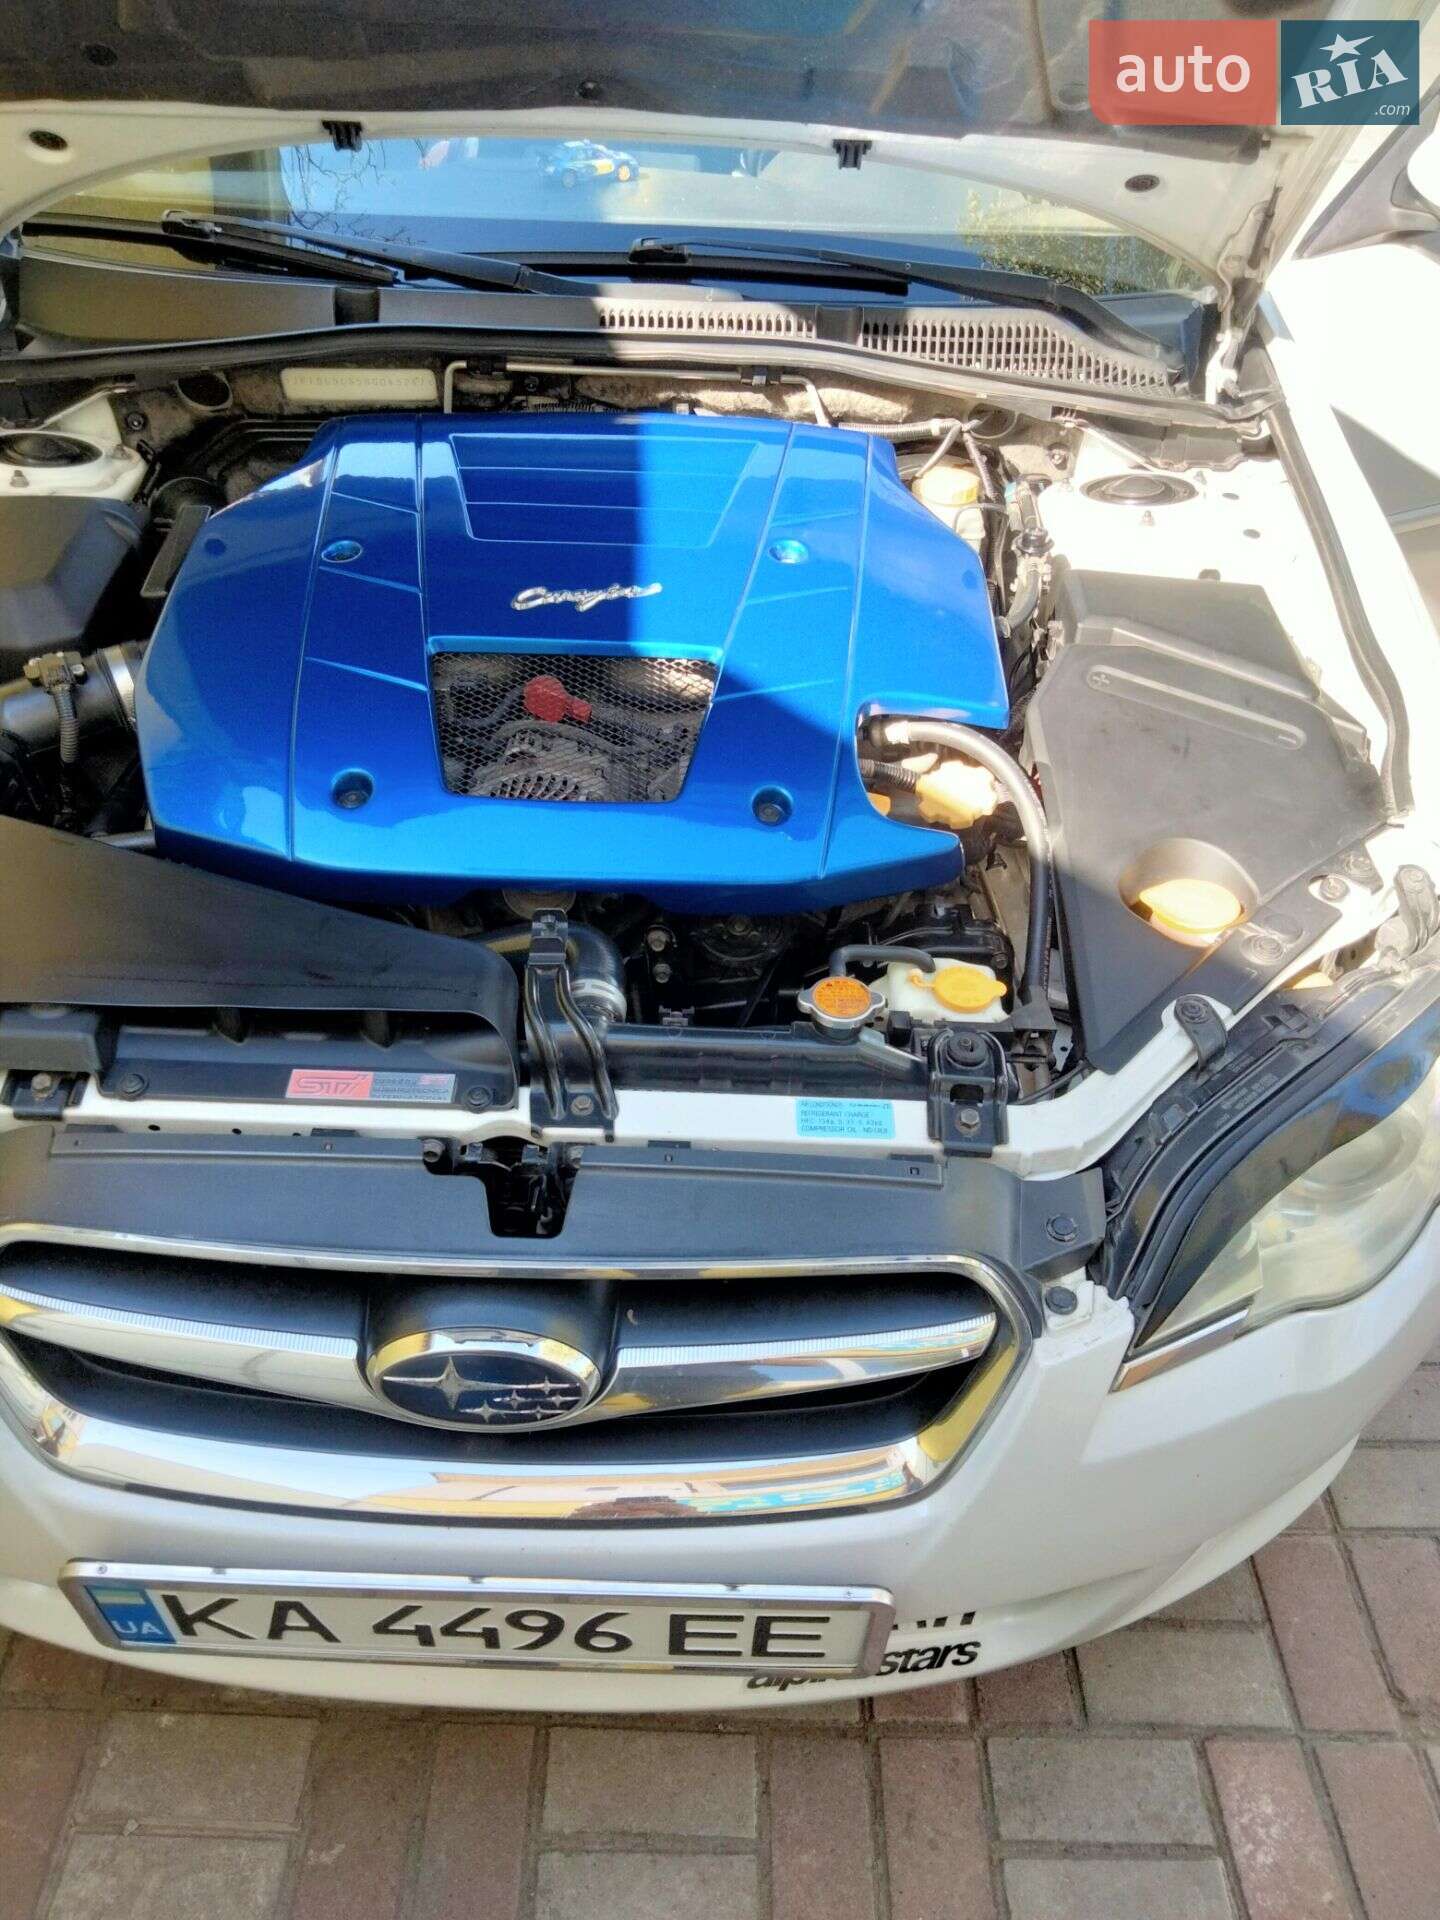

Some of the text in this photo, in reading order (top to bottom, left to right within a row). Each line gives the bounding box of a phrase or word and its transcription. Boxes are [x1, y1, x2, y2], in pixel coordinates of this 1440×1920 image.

[113, 1620, 164, 1636] UA
[161, 1594, 831, 1658] KA 4496 EE
